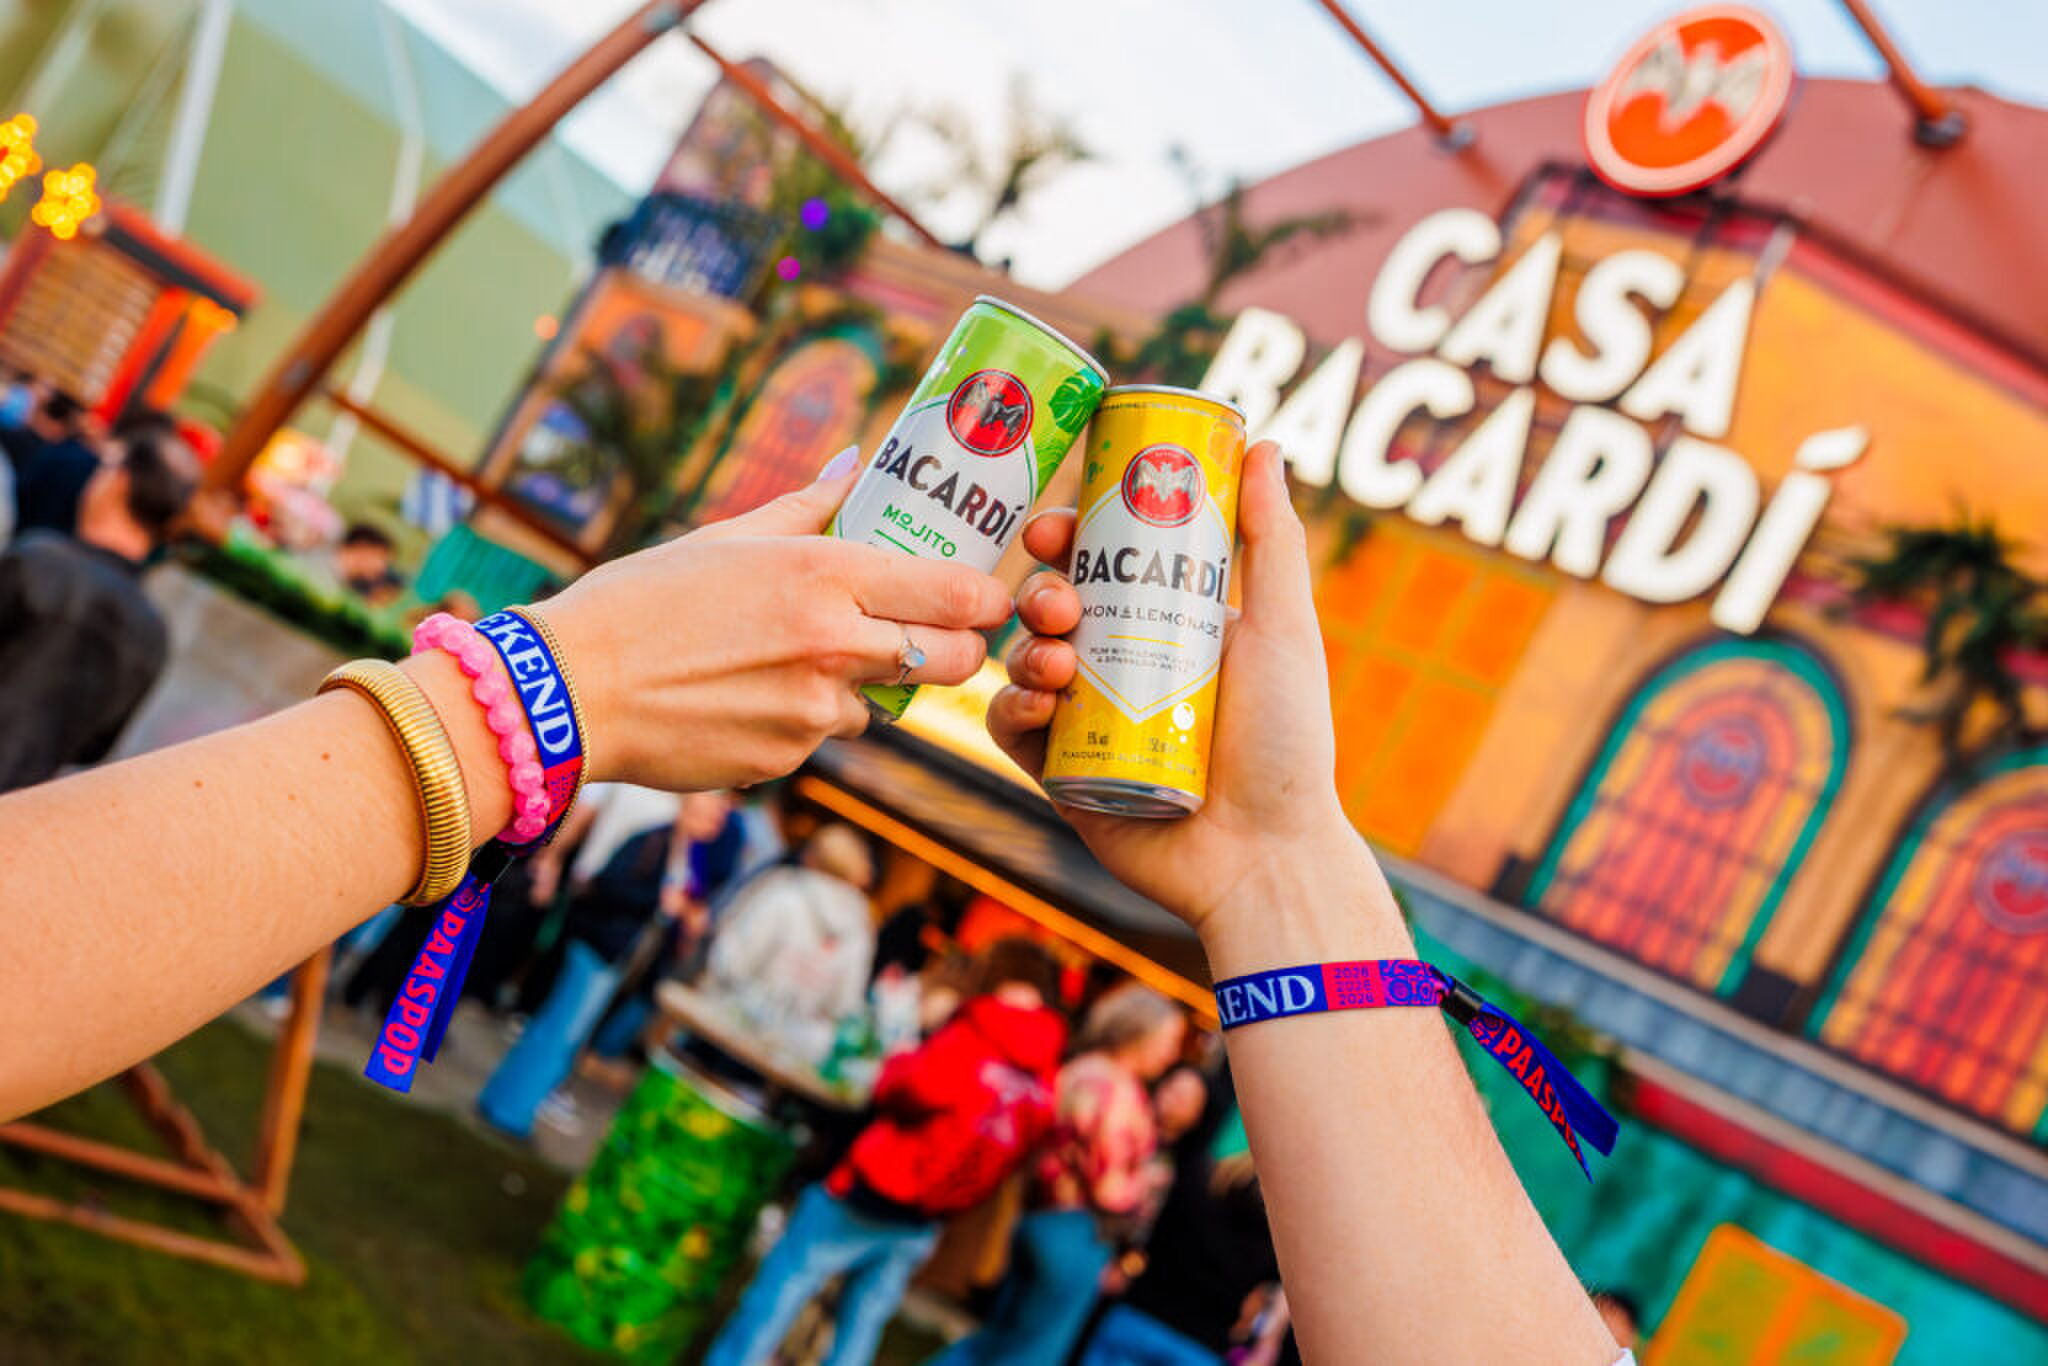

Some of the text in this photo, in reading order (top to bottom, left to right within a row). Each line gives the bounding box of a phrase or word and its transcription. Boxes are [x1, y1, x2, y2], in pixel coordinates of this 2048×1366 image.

[1366, 207, 1757, 439] CASA
[874, 436, 1025, 545] BACARDÍ
[882, 503, 957, 558] MOJITO
[1201, 306, 1870, 635] BACARDÍ
[1074, 547, 1228, 604] BACARDÍ
[379, 911, 466, 1076] PAASPOP
